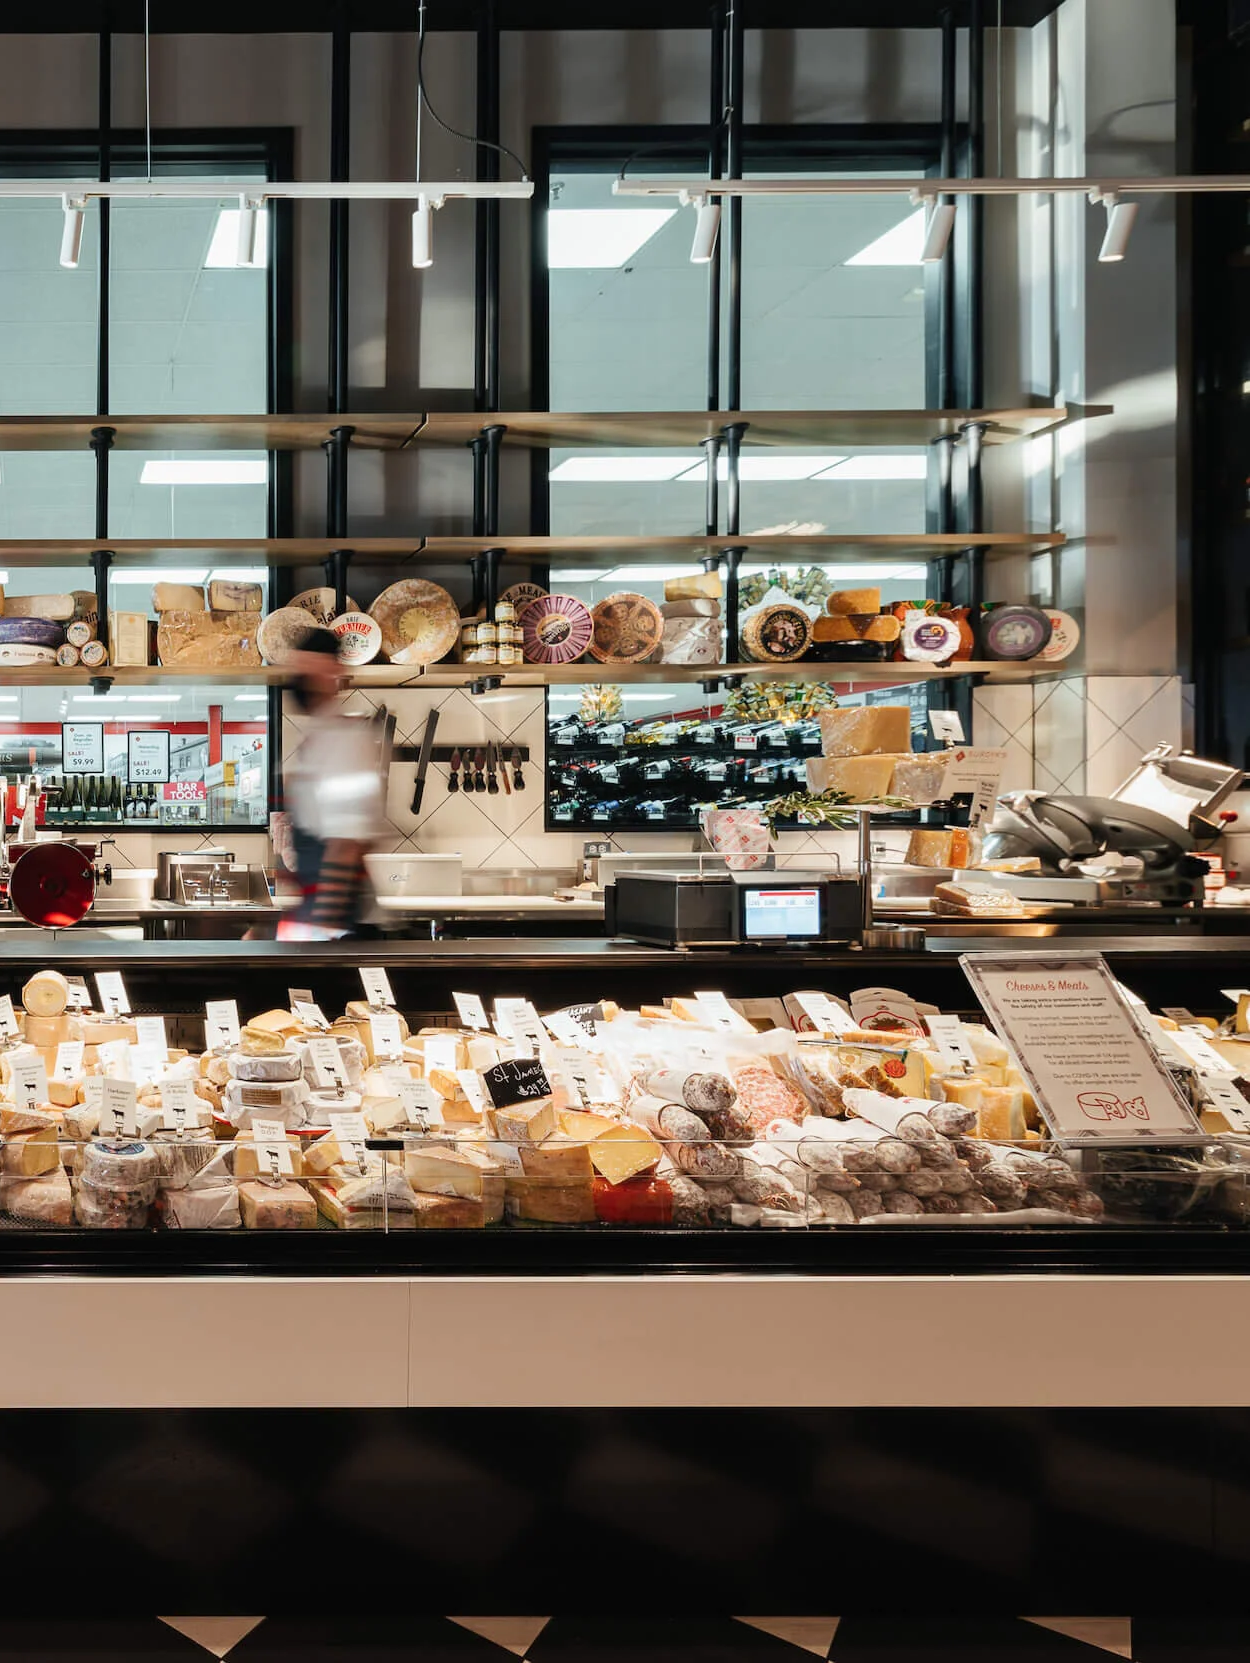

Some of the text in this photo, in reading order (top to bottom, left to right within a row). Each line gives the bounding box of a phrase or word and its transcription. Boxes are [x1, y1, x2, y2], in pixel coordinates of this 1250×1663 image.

[73, 758, 94, 766] $9.99
[177, 782, 197, 792] BAR
[170, 791, 204, 800] TOOLS
[1006, 980, 1090, 991] Cheeses & Meats
